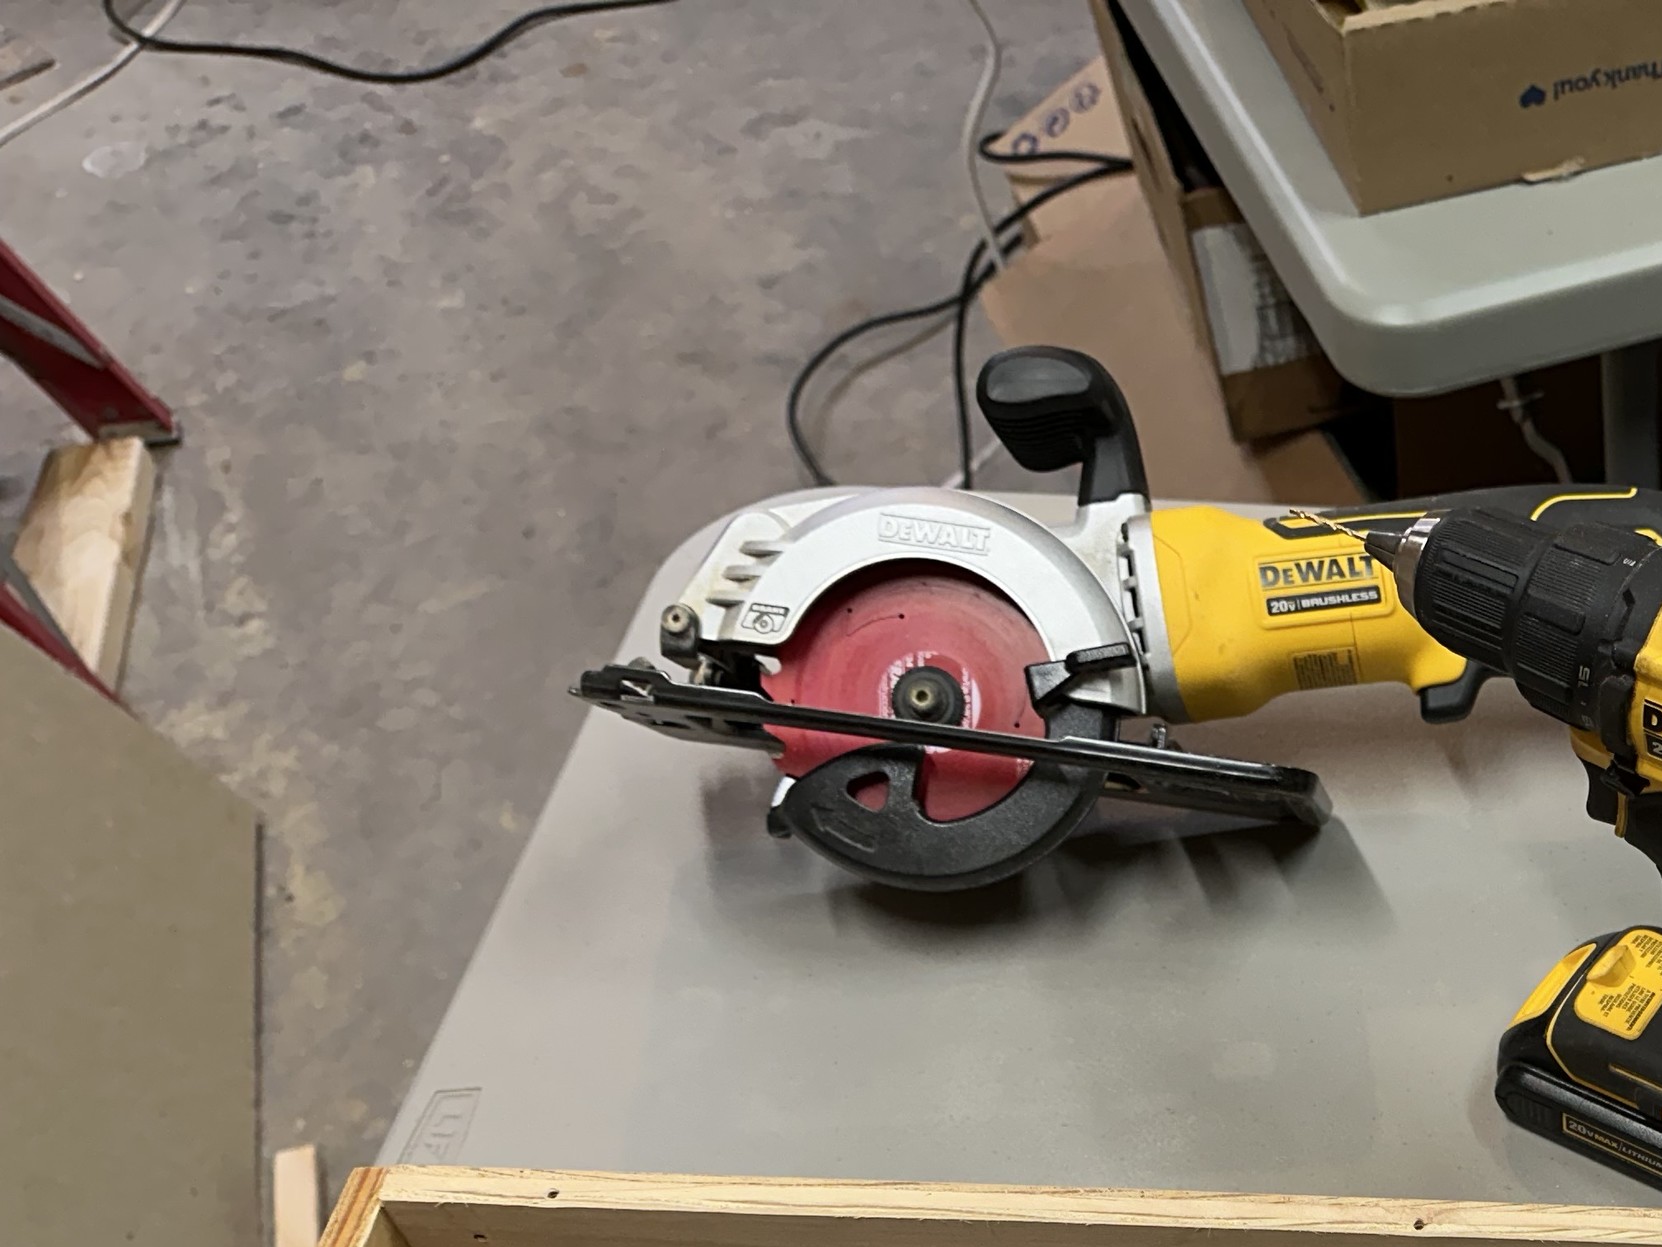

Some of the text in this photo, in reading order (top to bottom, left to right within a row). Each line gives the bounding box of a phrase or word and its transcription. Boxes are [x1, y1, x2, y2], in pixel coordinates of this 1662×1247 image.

[878, 514, 990, 551] DEWALT
[1259, 555, 1376, 589] DEWALT
[1301, 590, 1379, 609] BRUSHLESS
